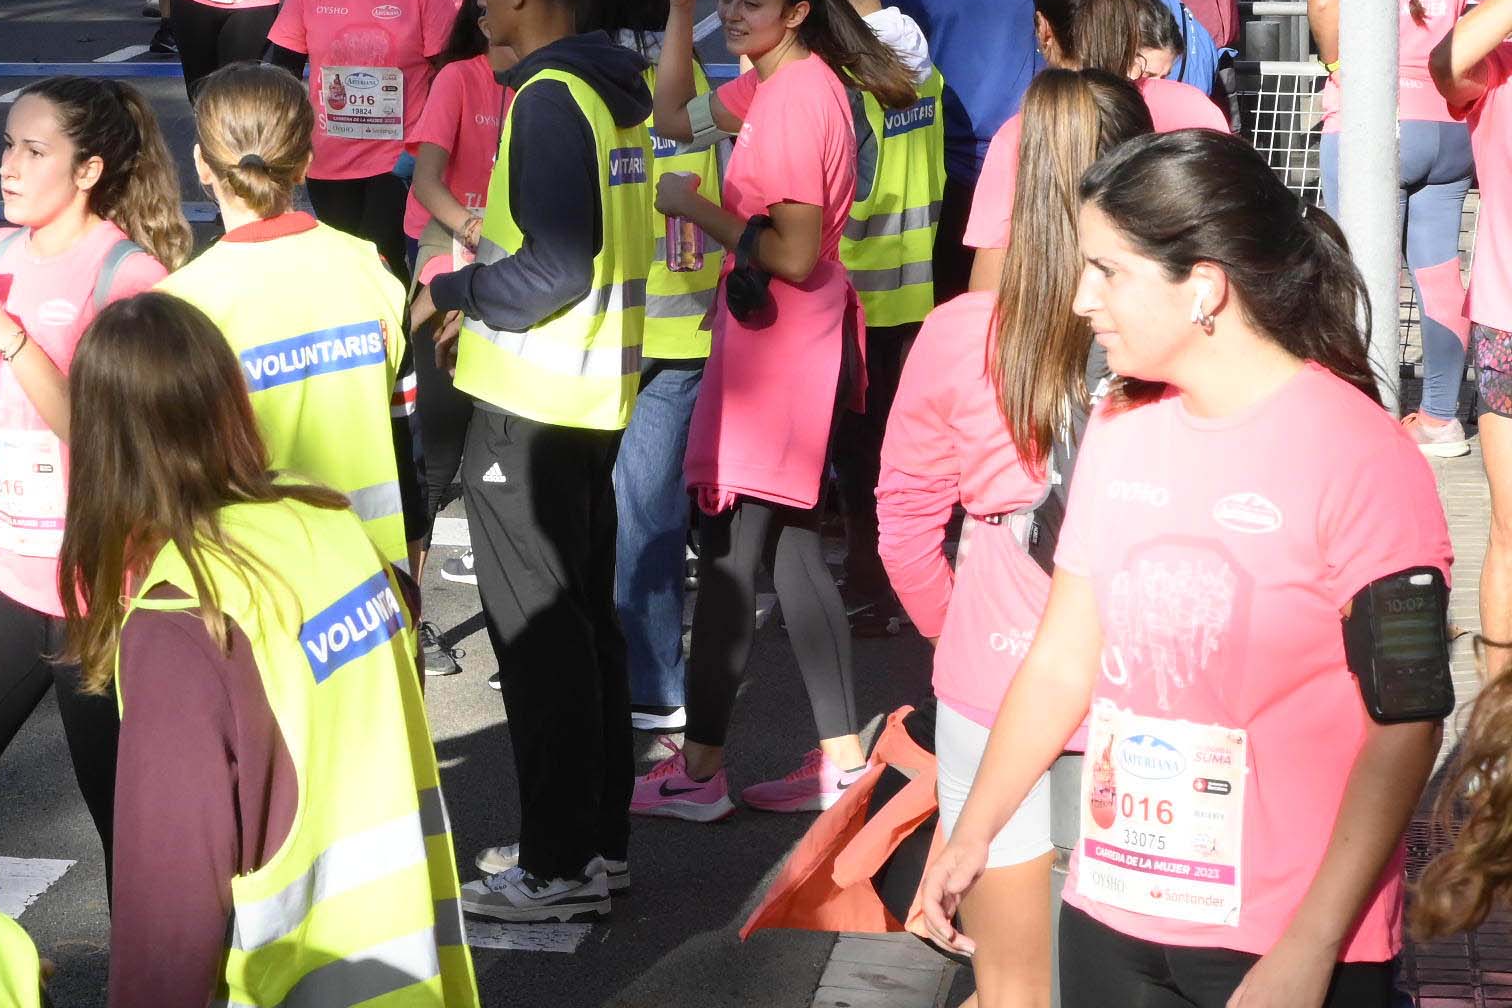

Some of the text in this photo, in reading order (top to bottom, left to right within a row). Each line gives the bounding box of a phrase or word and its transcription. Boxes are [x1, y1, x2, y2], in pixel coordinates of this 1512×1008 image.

[349, 94, 375, 105] 016
[246, 332, 383, 381] VOLUNTARIS
[1193, 751, 1232, 766] SUMA
[1121, 793, 1174, 825] 016
[1123, 829, 1167, 850] 33075
[1095, 845, 1220, 880] CARRERA DE LA MUJER 2023
[1165, 888, 1225, 907] Santander
